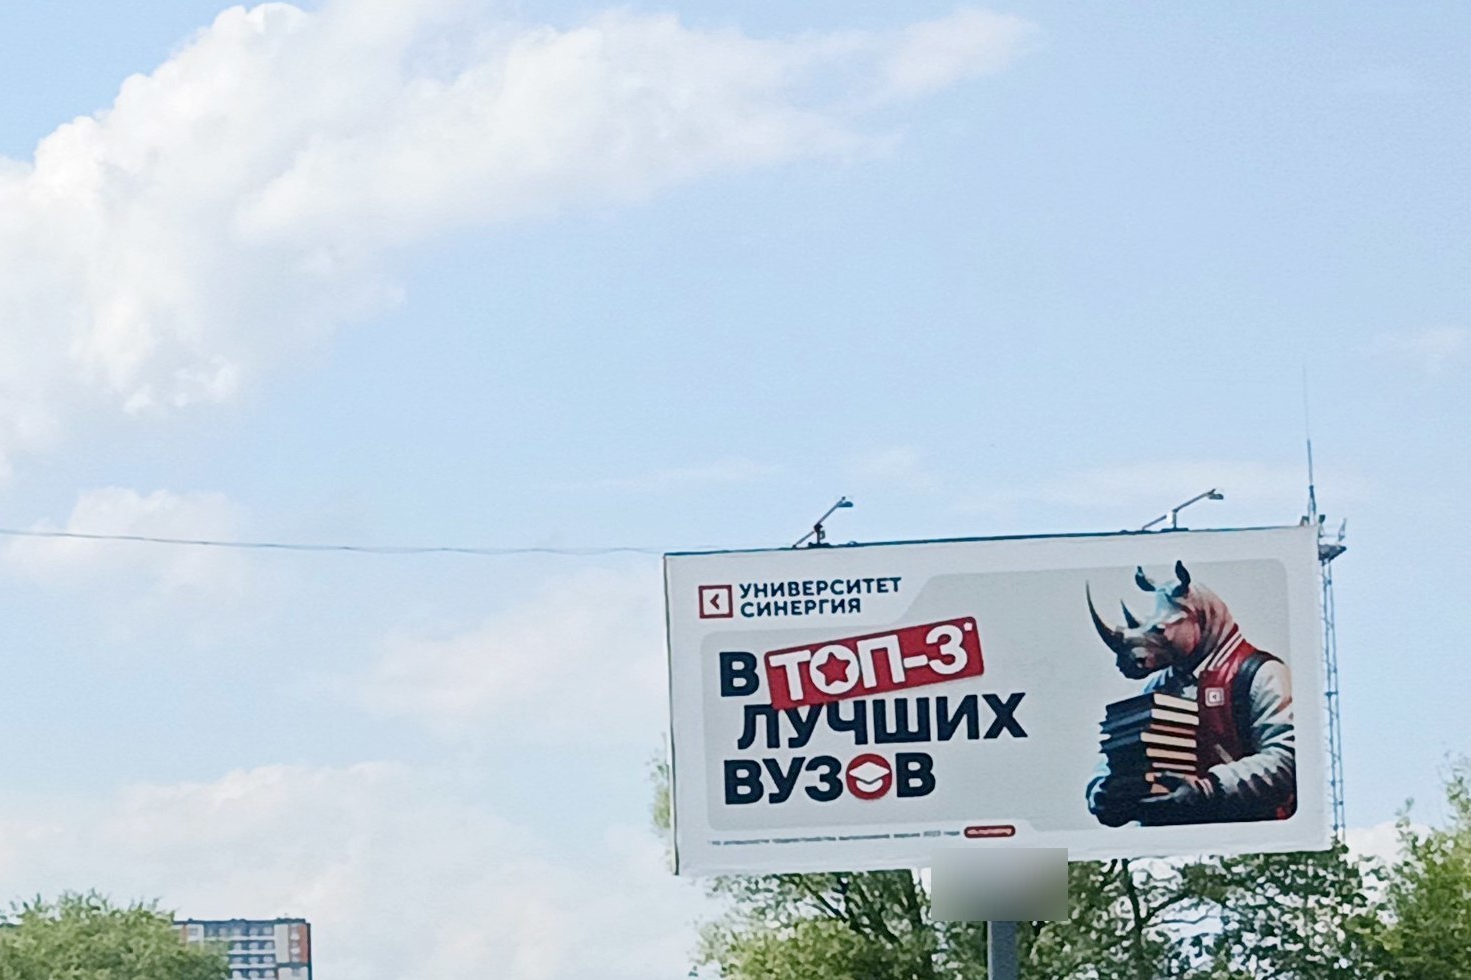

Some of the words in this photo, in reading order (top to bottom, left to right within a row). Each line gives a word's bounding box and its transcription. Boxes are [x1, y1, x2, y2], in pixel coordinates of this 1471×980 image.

[739, 576, 902, 599] УНИВЕРСИТЕТ
[740, 597, 862, 618] СИНЕРГИЯ
[719, 651, 760, 698] В
[737, 692, 1029, 750] ЛУЧШИХ
[723, 752, 937, 805] ВУЗОВ
